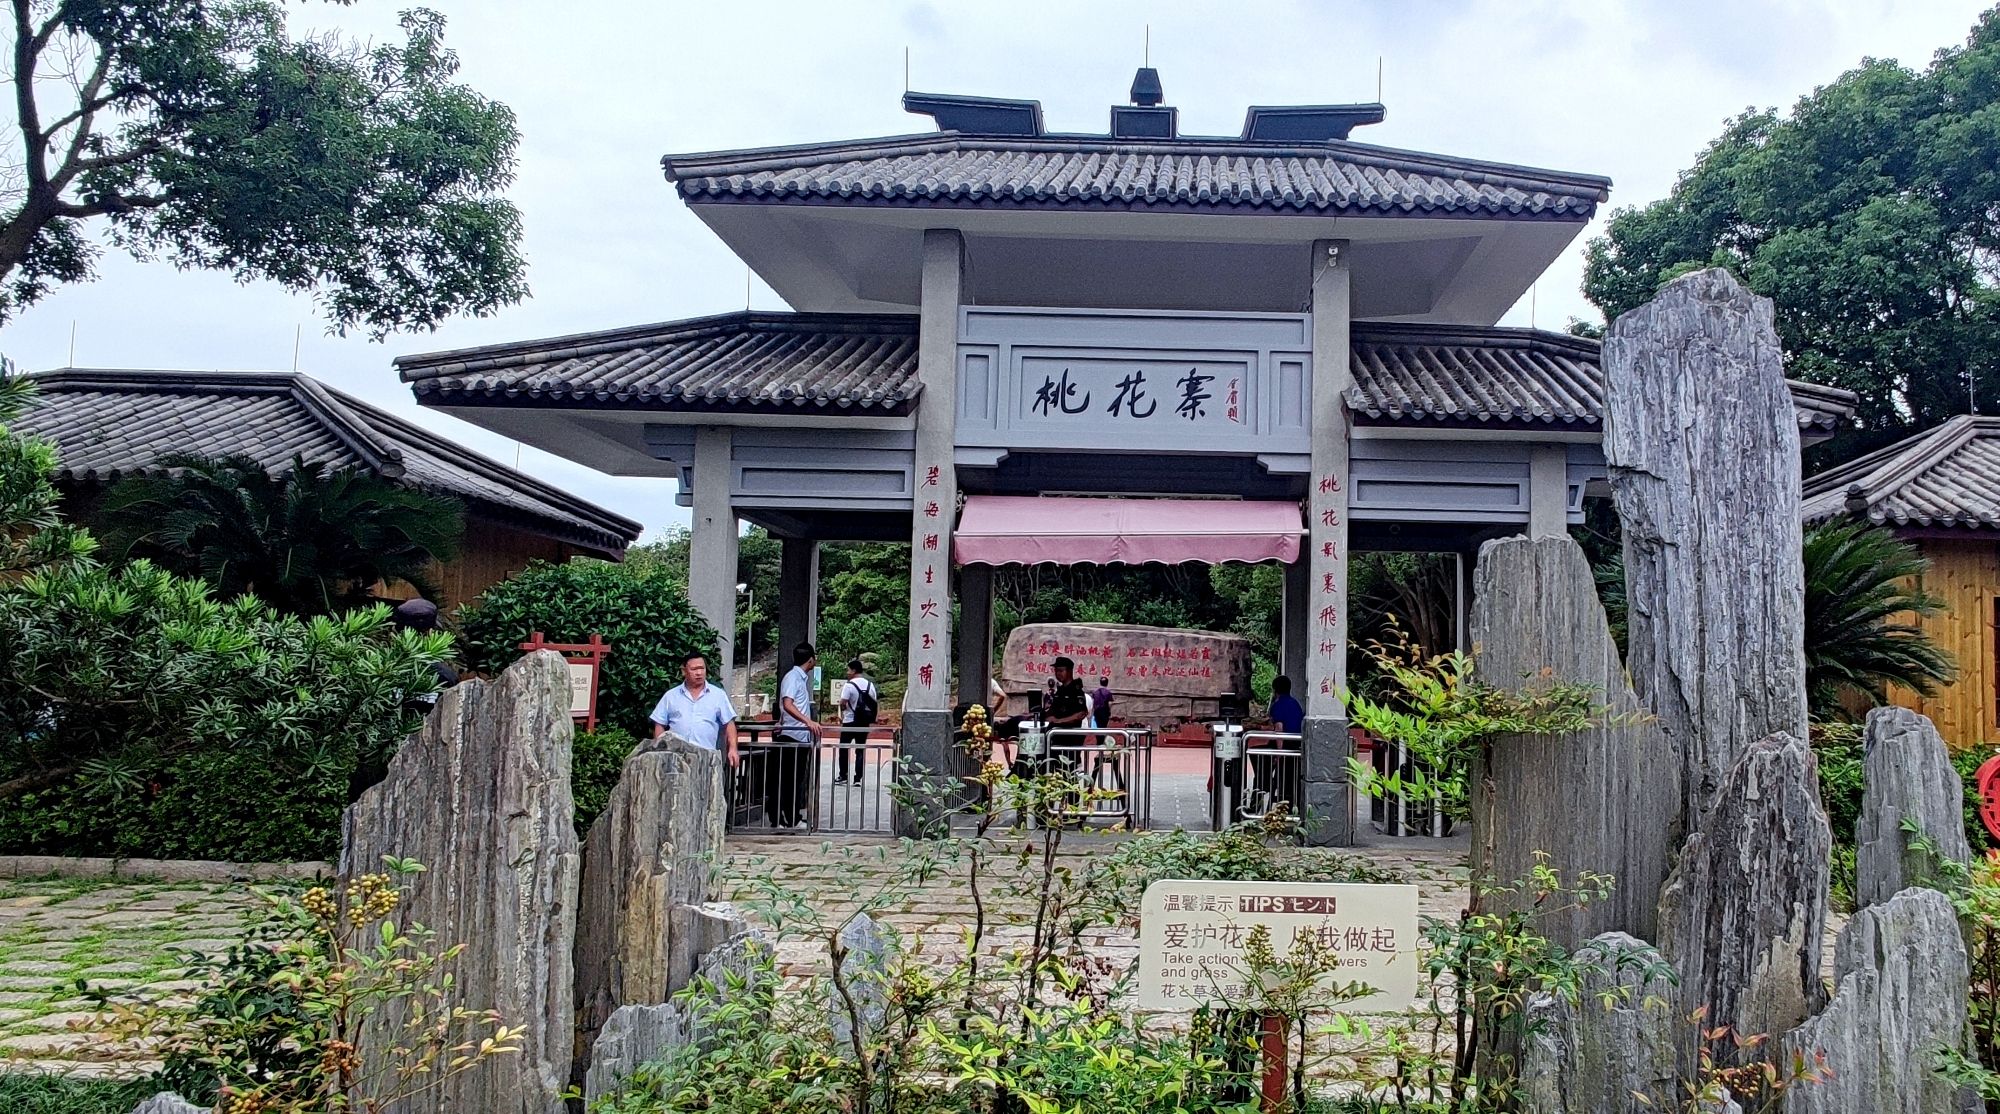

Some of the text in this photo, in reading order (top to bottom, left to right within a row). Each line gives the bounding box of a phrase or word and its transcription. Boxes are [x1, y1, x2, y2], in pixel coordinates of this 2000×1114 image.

[1032, 367, 1216, 421] 桃花寨
[1163, 894, 1234, 912] 温馨提示
[1242, 896, 1334, 913] TIPS ヒント
[1162, 951, 1193, 964] Take
[1199, 953, 1239, 965] action
[1161, 966, 1228, 981] and grass
